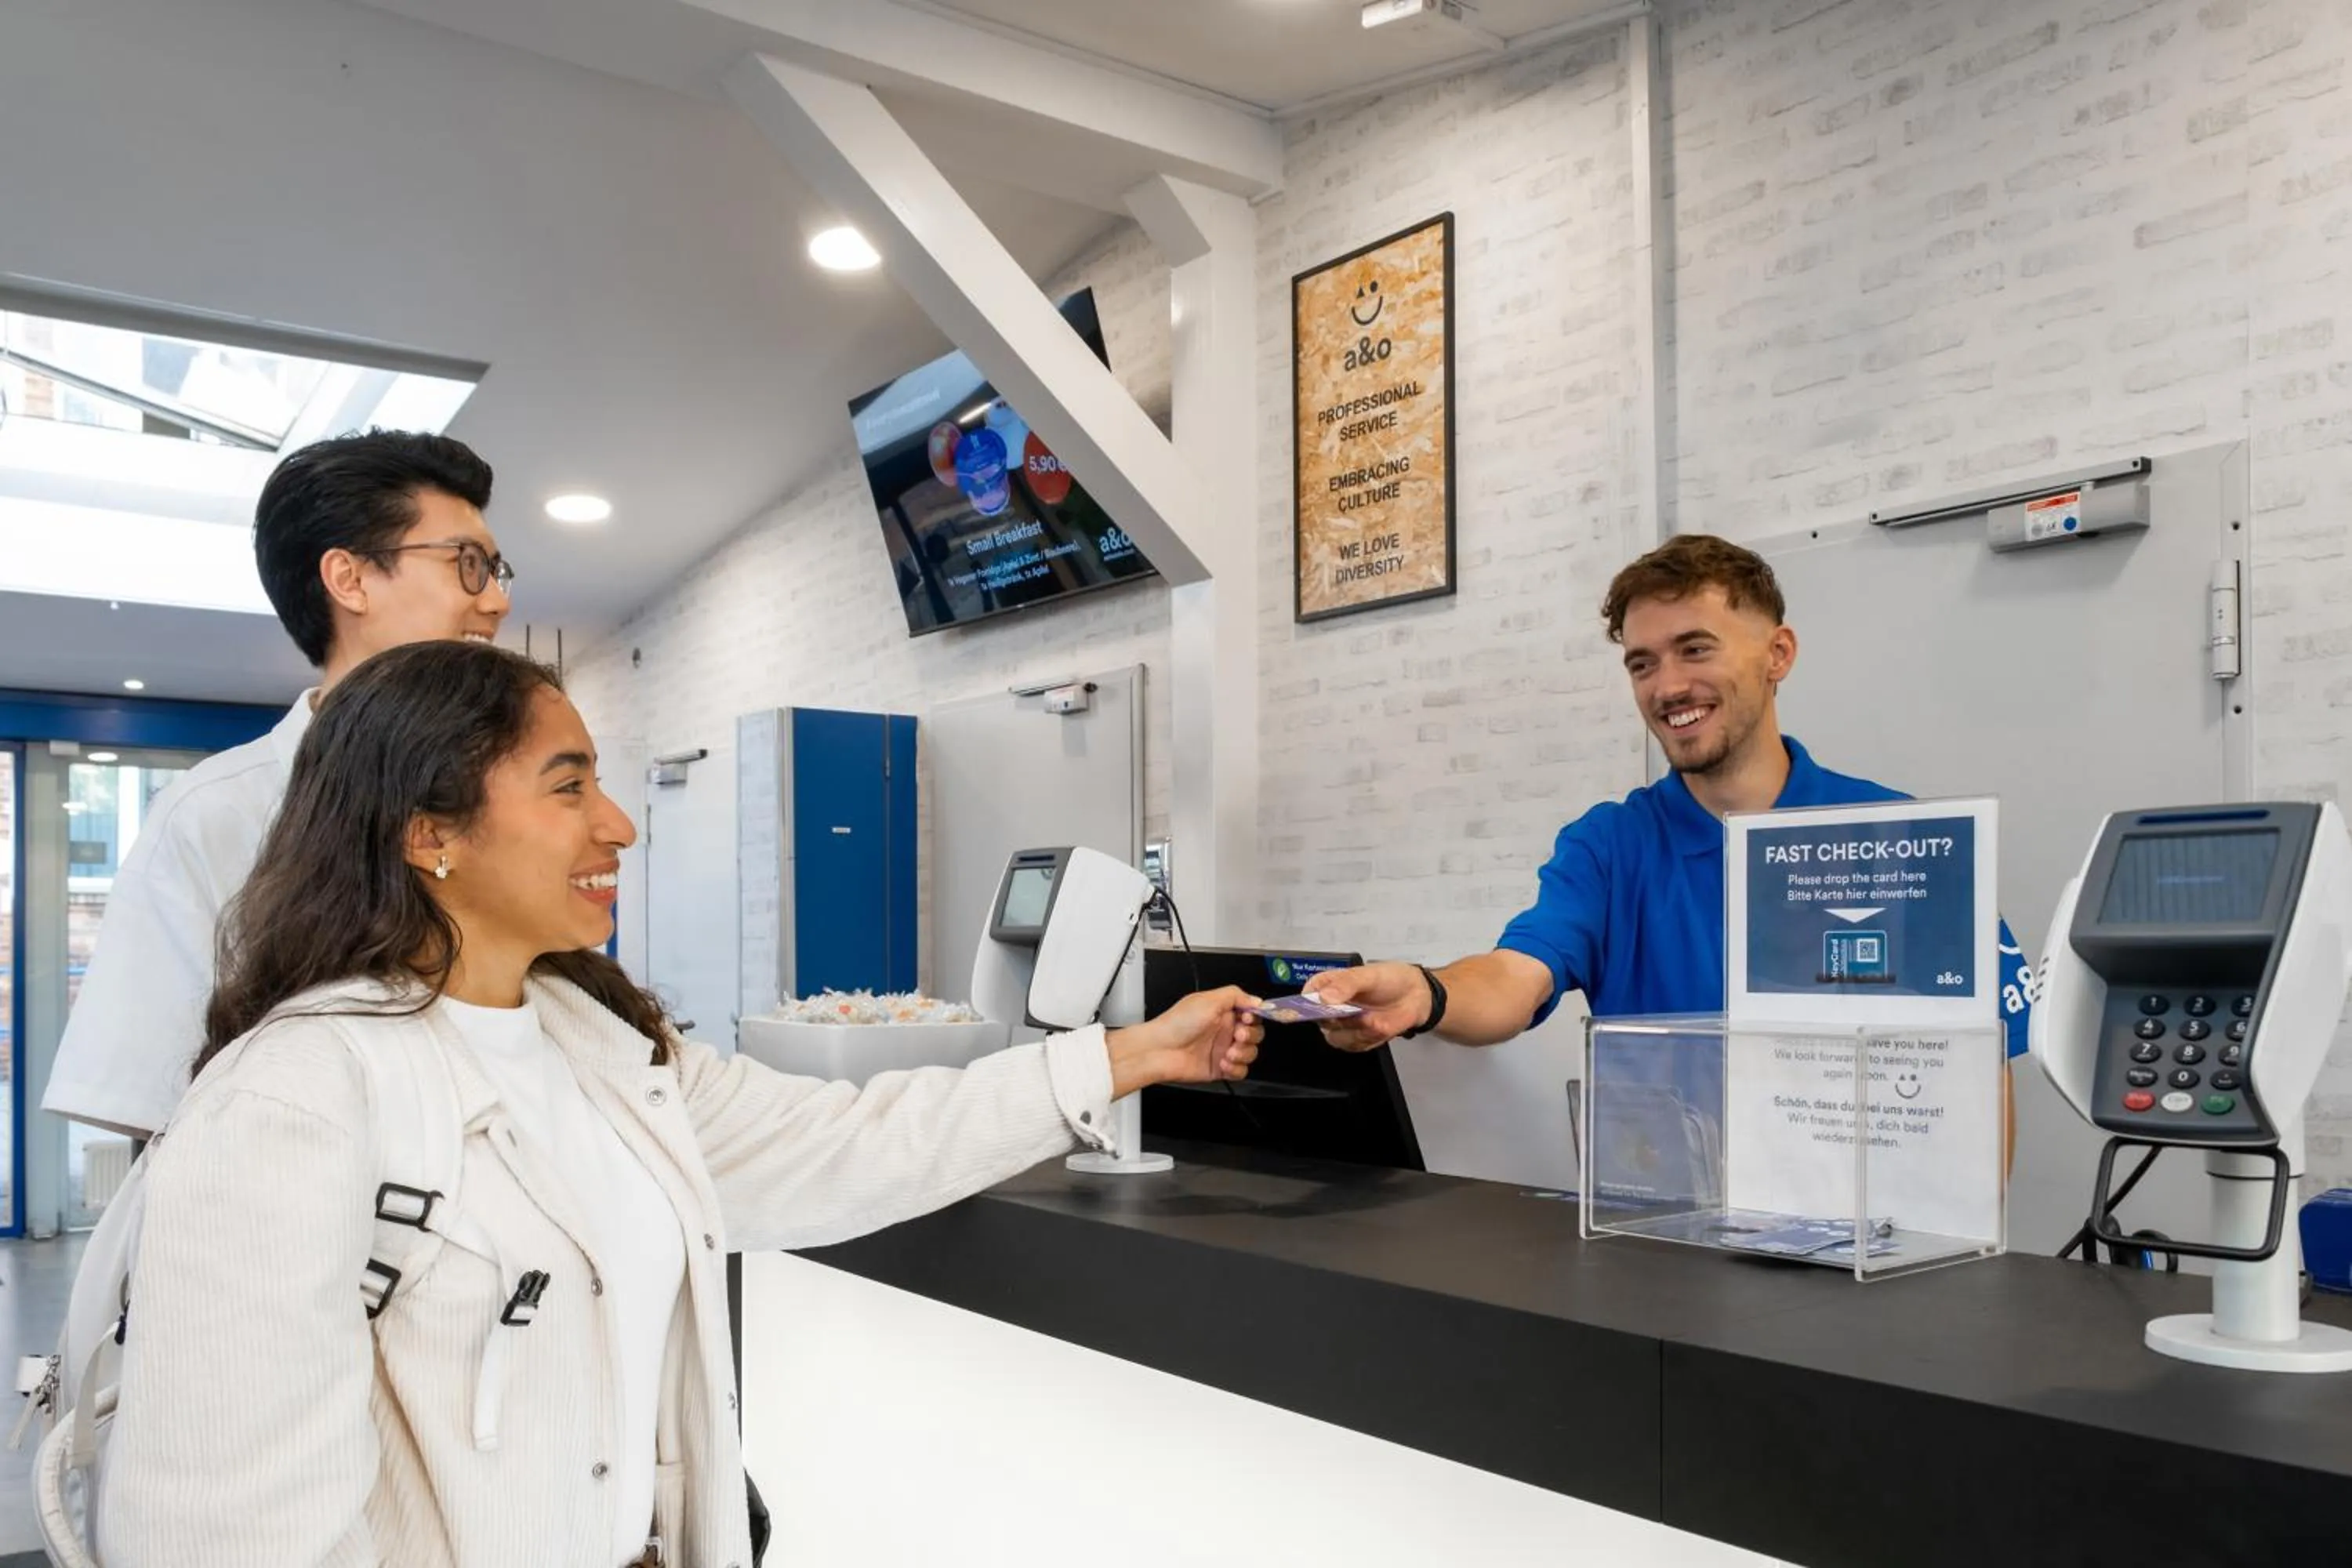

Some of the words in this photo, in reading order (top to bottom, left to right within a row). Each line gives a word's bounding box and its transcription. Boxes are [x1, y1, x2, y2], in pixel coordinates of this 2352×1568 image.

[1344, 336, 1392, 372] a&o
[1318, 381, 1421, 426] PROFESSIONAL
[1340, 411, 1398, 441] SERVICE
[1329, 456, 1410, 492] EMBRACING
[1338, 481, 1400, 513] CULTURE
[966, 534, 995, 556] Small
[994, 521, 1043, 546] Breakfast
[1340, 543, 1360, 561] WE
[1363, 533, 1400, 557] LOVE
[1336, 555, 1404, 585] DIVERSITY
[1765, 844, 1813, 864] FAST
[1817, 837, 1954, 862] CHECK-OUT?
[1788, 873, 1821, 886] Please
[1824, 873, 1849, 887] drop
[1853, 872, 1871, 884] the
[1873, 871, 1898, 883] card
[1900, 870, 1926, 882] here
[1788, 890, 1811, 902] Bitte
[1814, 889, 1843, 901] Karte
[1846, 888, 1867, 900] hier
[1870, 887, 1927, 899] einwerfen
[1936, 971, 1964, 985] a&o
[2003, 965, 2034, 1014] a&
[2151, 996, 2157, 1007] 1
[2195, 997, 2204, 1007] 2
[2244, 997, 2252, 1007] 3
[2144, 1018, 2154, 1029] 4
[2190, 1022, 2199, 1031] 5
[2236, 1022, 2245, 1032] 6
[1894, 1040, 1915, 1051] you
[1918, 1040, 1948, 1051] here!
[2142, 1043, 2151, 1053] 7
[2184, 1045, 2194, 1055] 8
[2230, 1046, 2239, 1056] 9
[1774, 1048, 1791, 1058] We
[1795, 1050, 1816, 1060] look
[1869, 1054, 1880, 1064] to
[1882, 1056, 1920, 1069] seeing
[1923, 1058, 1944, 1069] you
[1823, 1069, 1853, 1080] again
[2178, 1071, 2188, 1081] 0
[1774, 1095, 1811, 1109] Schön,
[1813, 1099, 1837, 1110] dass
[1840, 1100, 1855, 1112] du
[1882, 1105, 1903, 1115] uns
[1906, 1106, 1944, 1117] warst!
[1788, 1112, 1807, 1123] Wir
[1876, 1120, 1900, 1131] dich
[1903, 1121, 1929, 1134] bald
